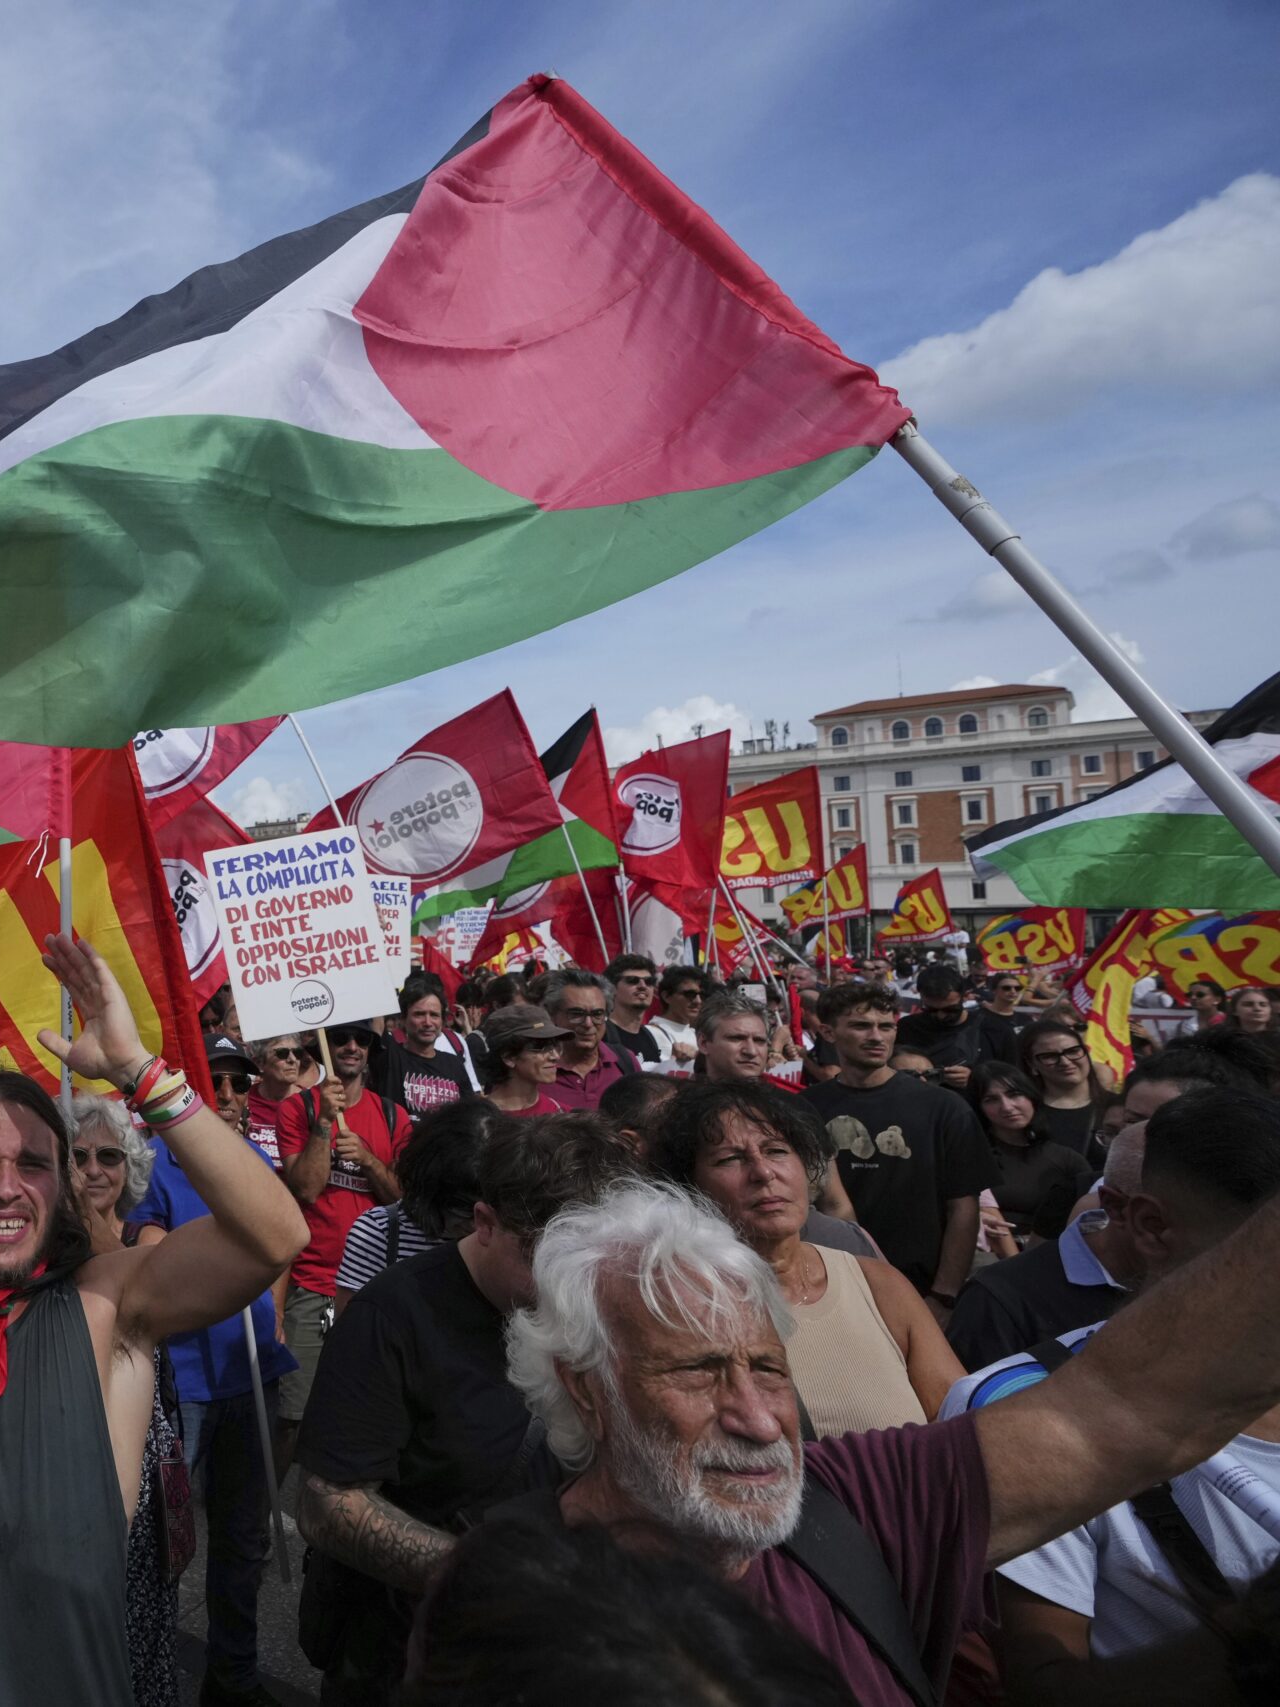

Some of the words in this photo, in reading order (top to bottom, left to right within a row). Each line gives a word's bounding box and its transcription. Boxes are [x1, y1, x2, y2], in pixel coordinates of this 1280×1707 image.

[213, 836, 356, 877] FERMIAMO
[217, 878, 242, 900] LA
[225, 904, 249, 924] DI
[255, 884, 353, 919] GOVERNO
[230, 926, 245, 944] E
[250, 913, 312, 942] FINTE
[236, 926, 368, 968] OPPOSIZIONI
[241, 963, 282, 988] CON
[287, 945, 379, 978] ISRAELE
[291, 996, 320, 1008] potere
